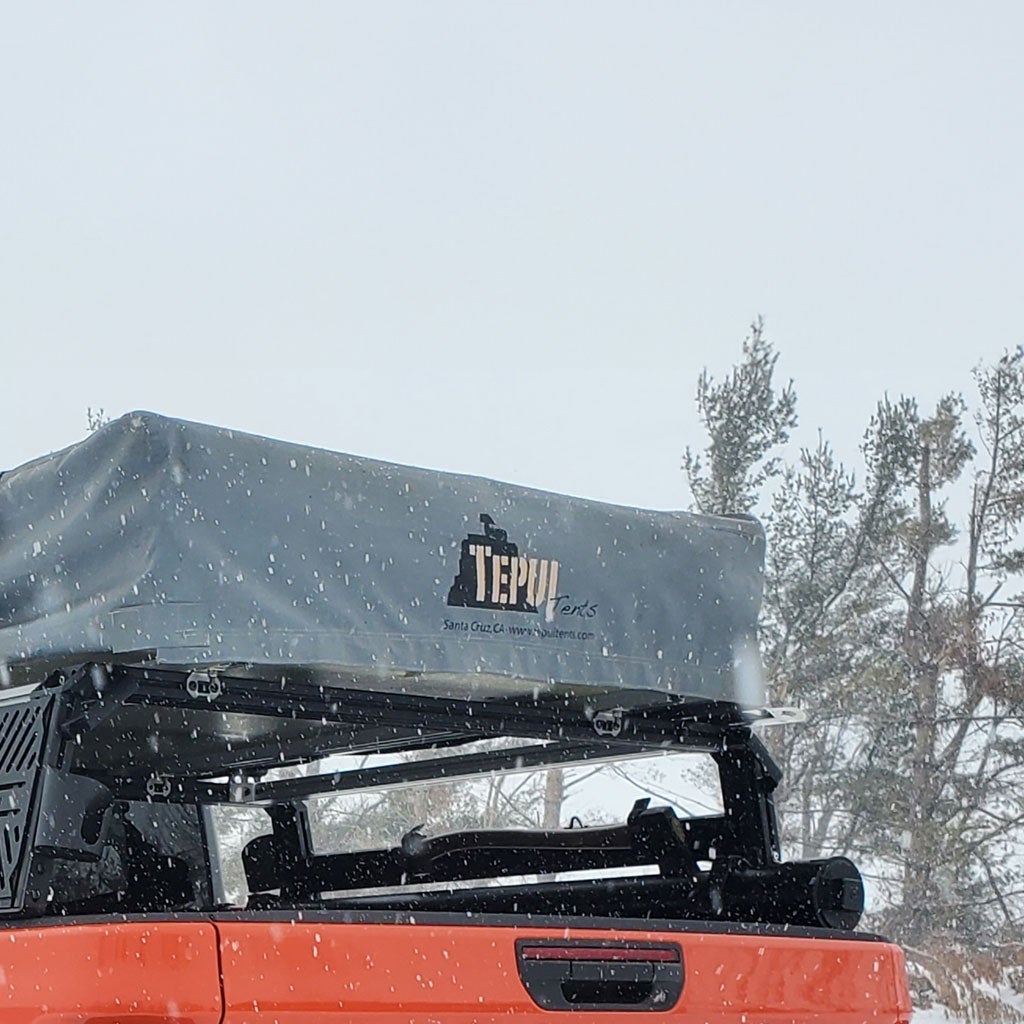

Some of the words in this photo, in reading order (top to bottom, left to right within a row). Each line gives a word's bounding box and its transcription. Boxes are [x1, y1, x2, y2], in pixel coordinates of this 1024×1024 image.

[469, 544, 559, 622] TEPUI
[550, 596, 598, 618] Tents
[443, 619, 469, 631] Santa
[508, 625, 595, 640] www.epuitents.com
